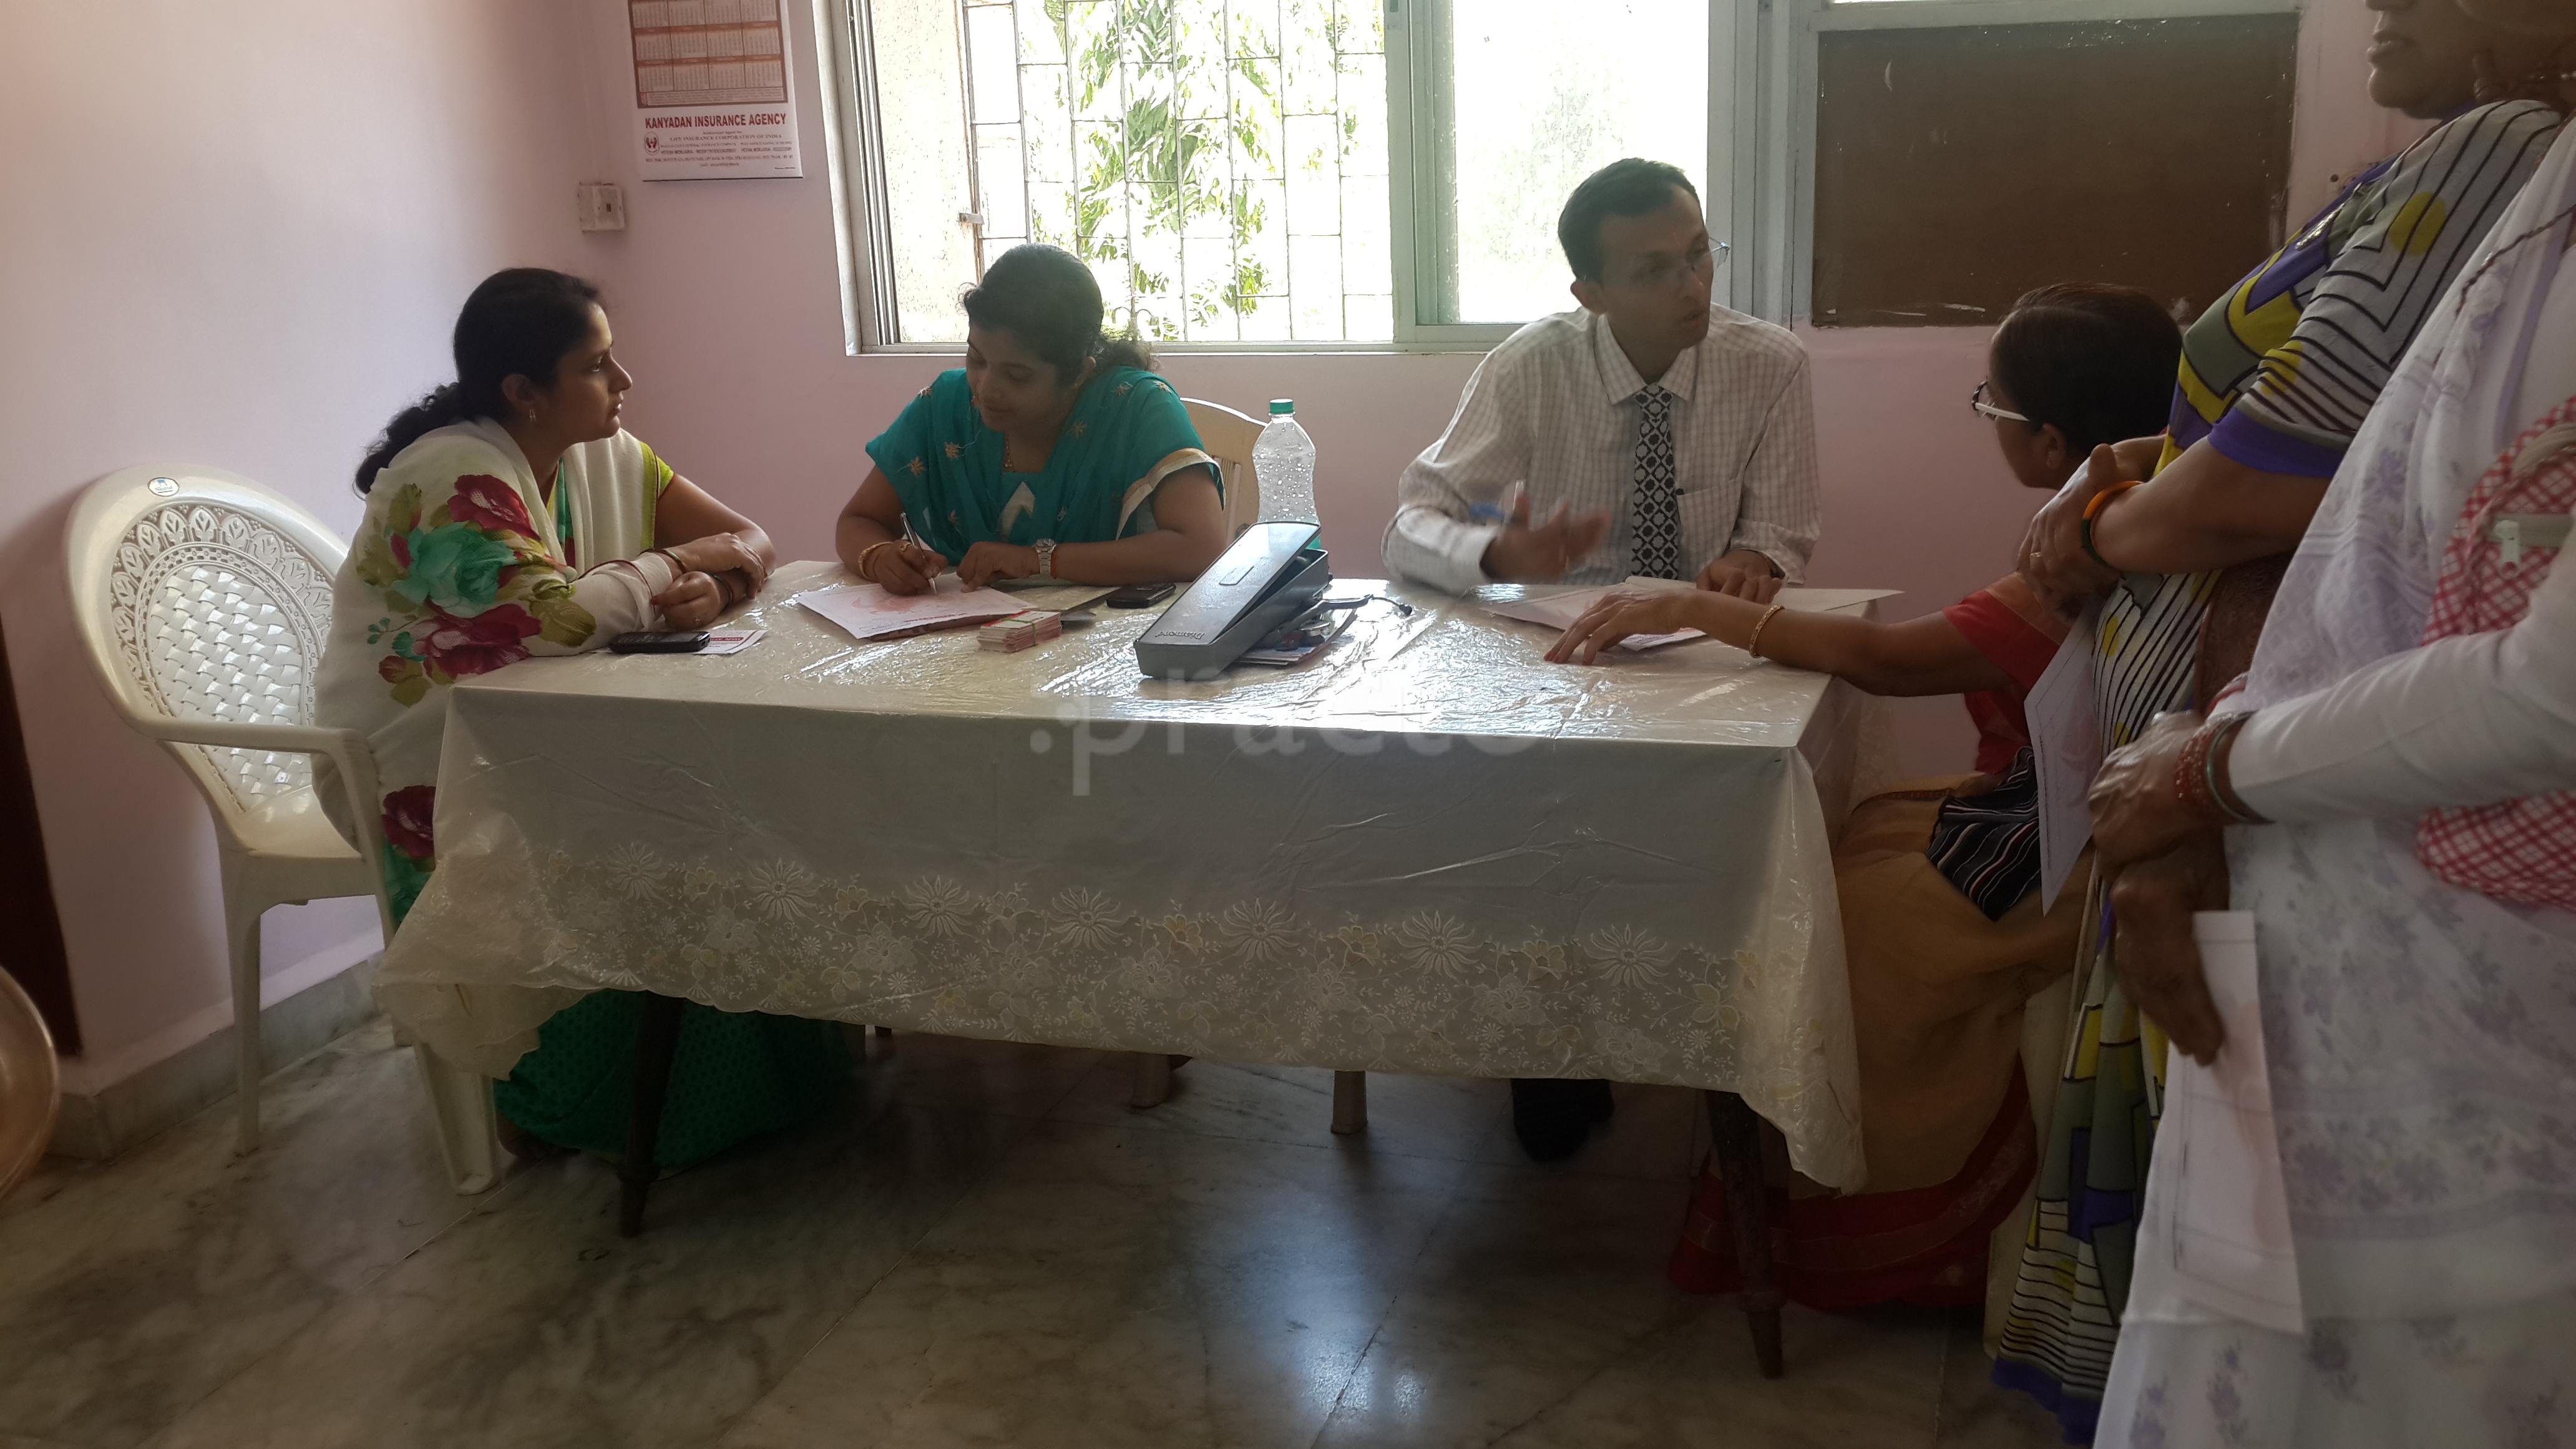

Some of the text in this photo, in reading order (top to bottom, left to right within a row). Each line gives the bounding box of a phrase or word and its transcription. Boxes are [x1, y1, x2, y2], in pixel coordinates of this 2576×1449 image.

[645, 113, 786, 129] KANYADAN INSURANCE AGENCY
[1154, 631, 1205, 640] Diamond
